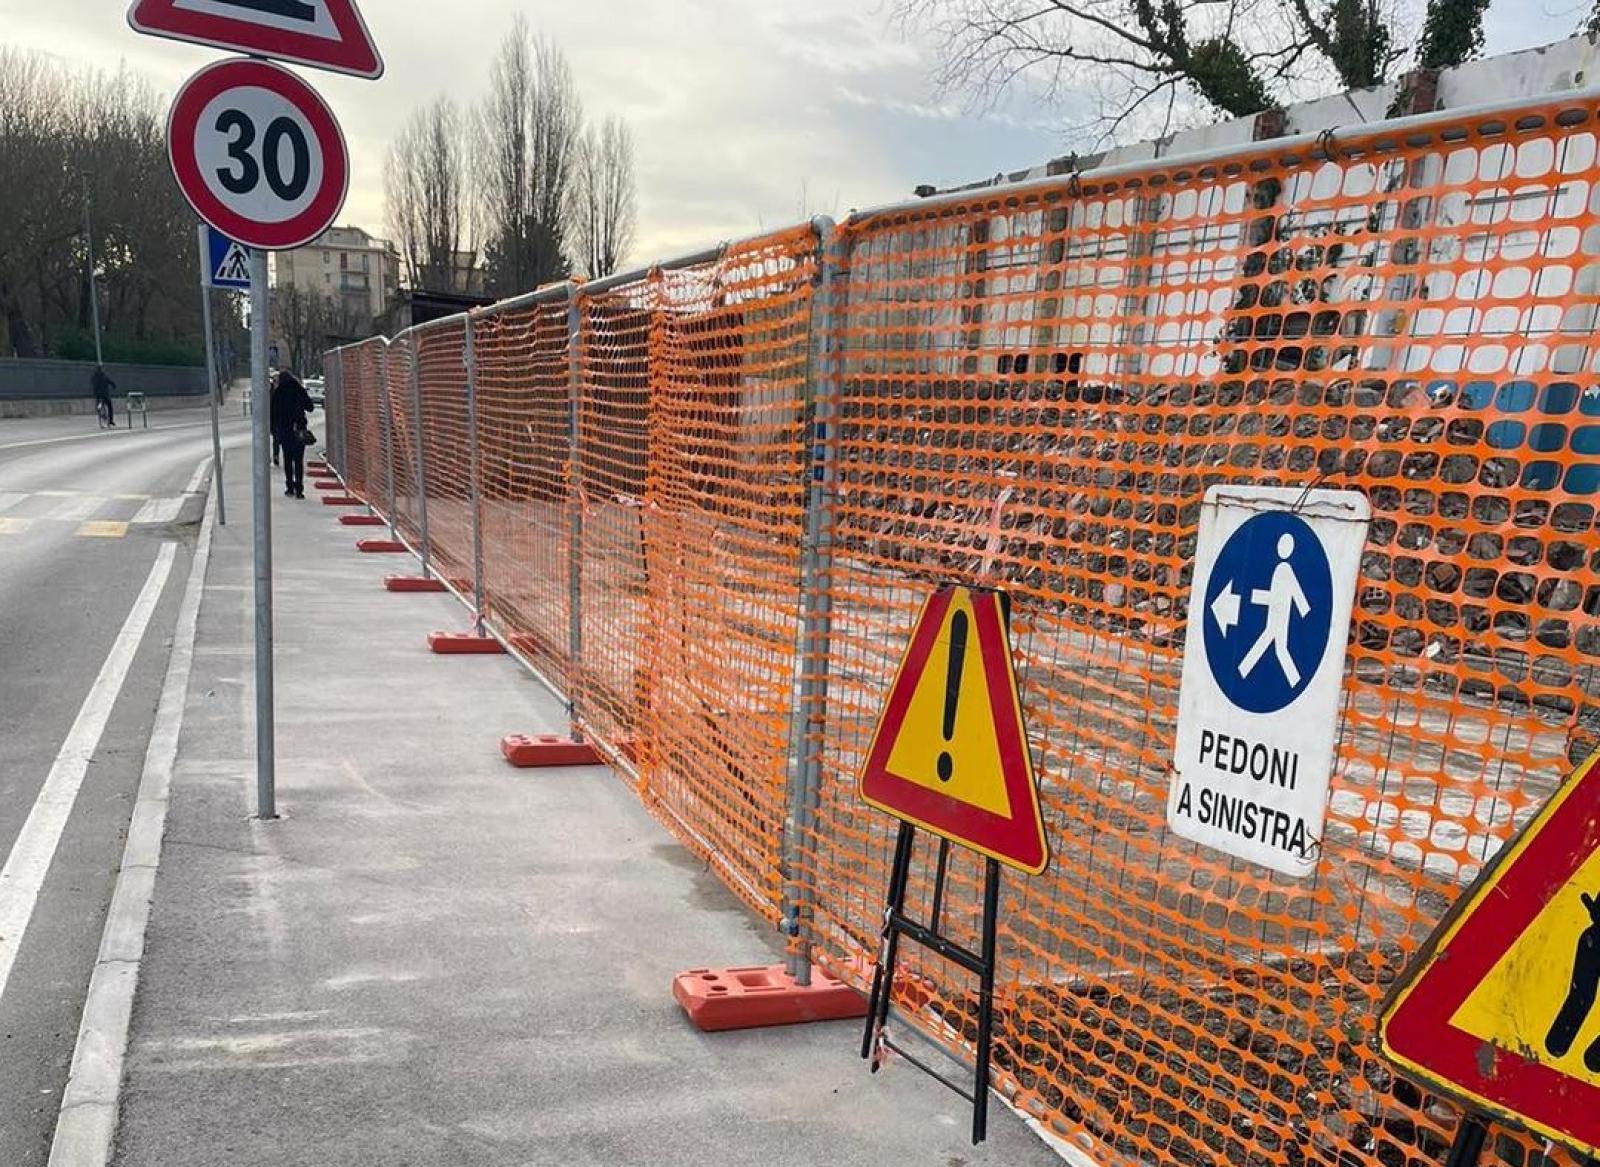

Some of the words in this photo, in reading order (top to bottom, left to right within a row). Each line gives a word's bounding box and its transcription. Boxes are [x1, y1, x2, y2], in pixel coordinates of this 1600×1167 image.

[214, 109, 311, 202] 30
[1199, 729, 1299, 790] PEDONI
[1176, 782, 1192, 818] A
[1197, 788, 1306, 858] SINISTRA
